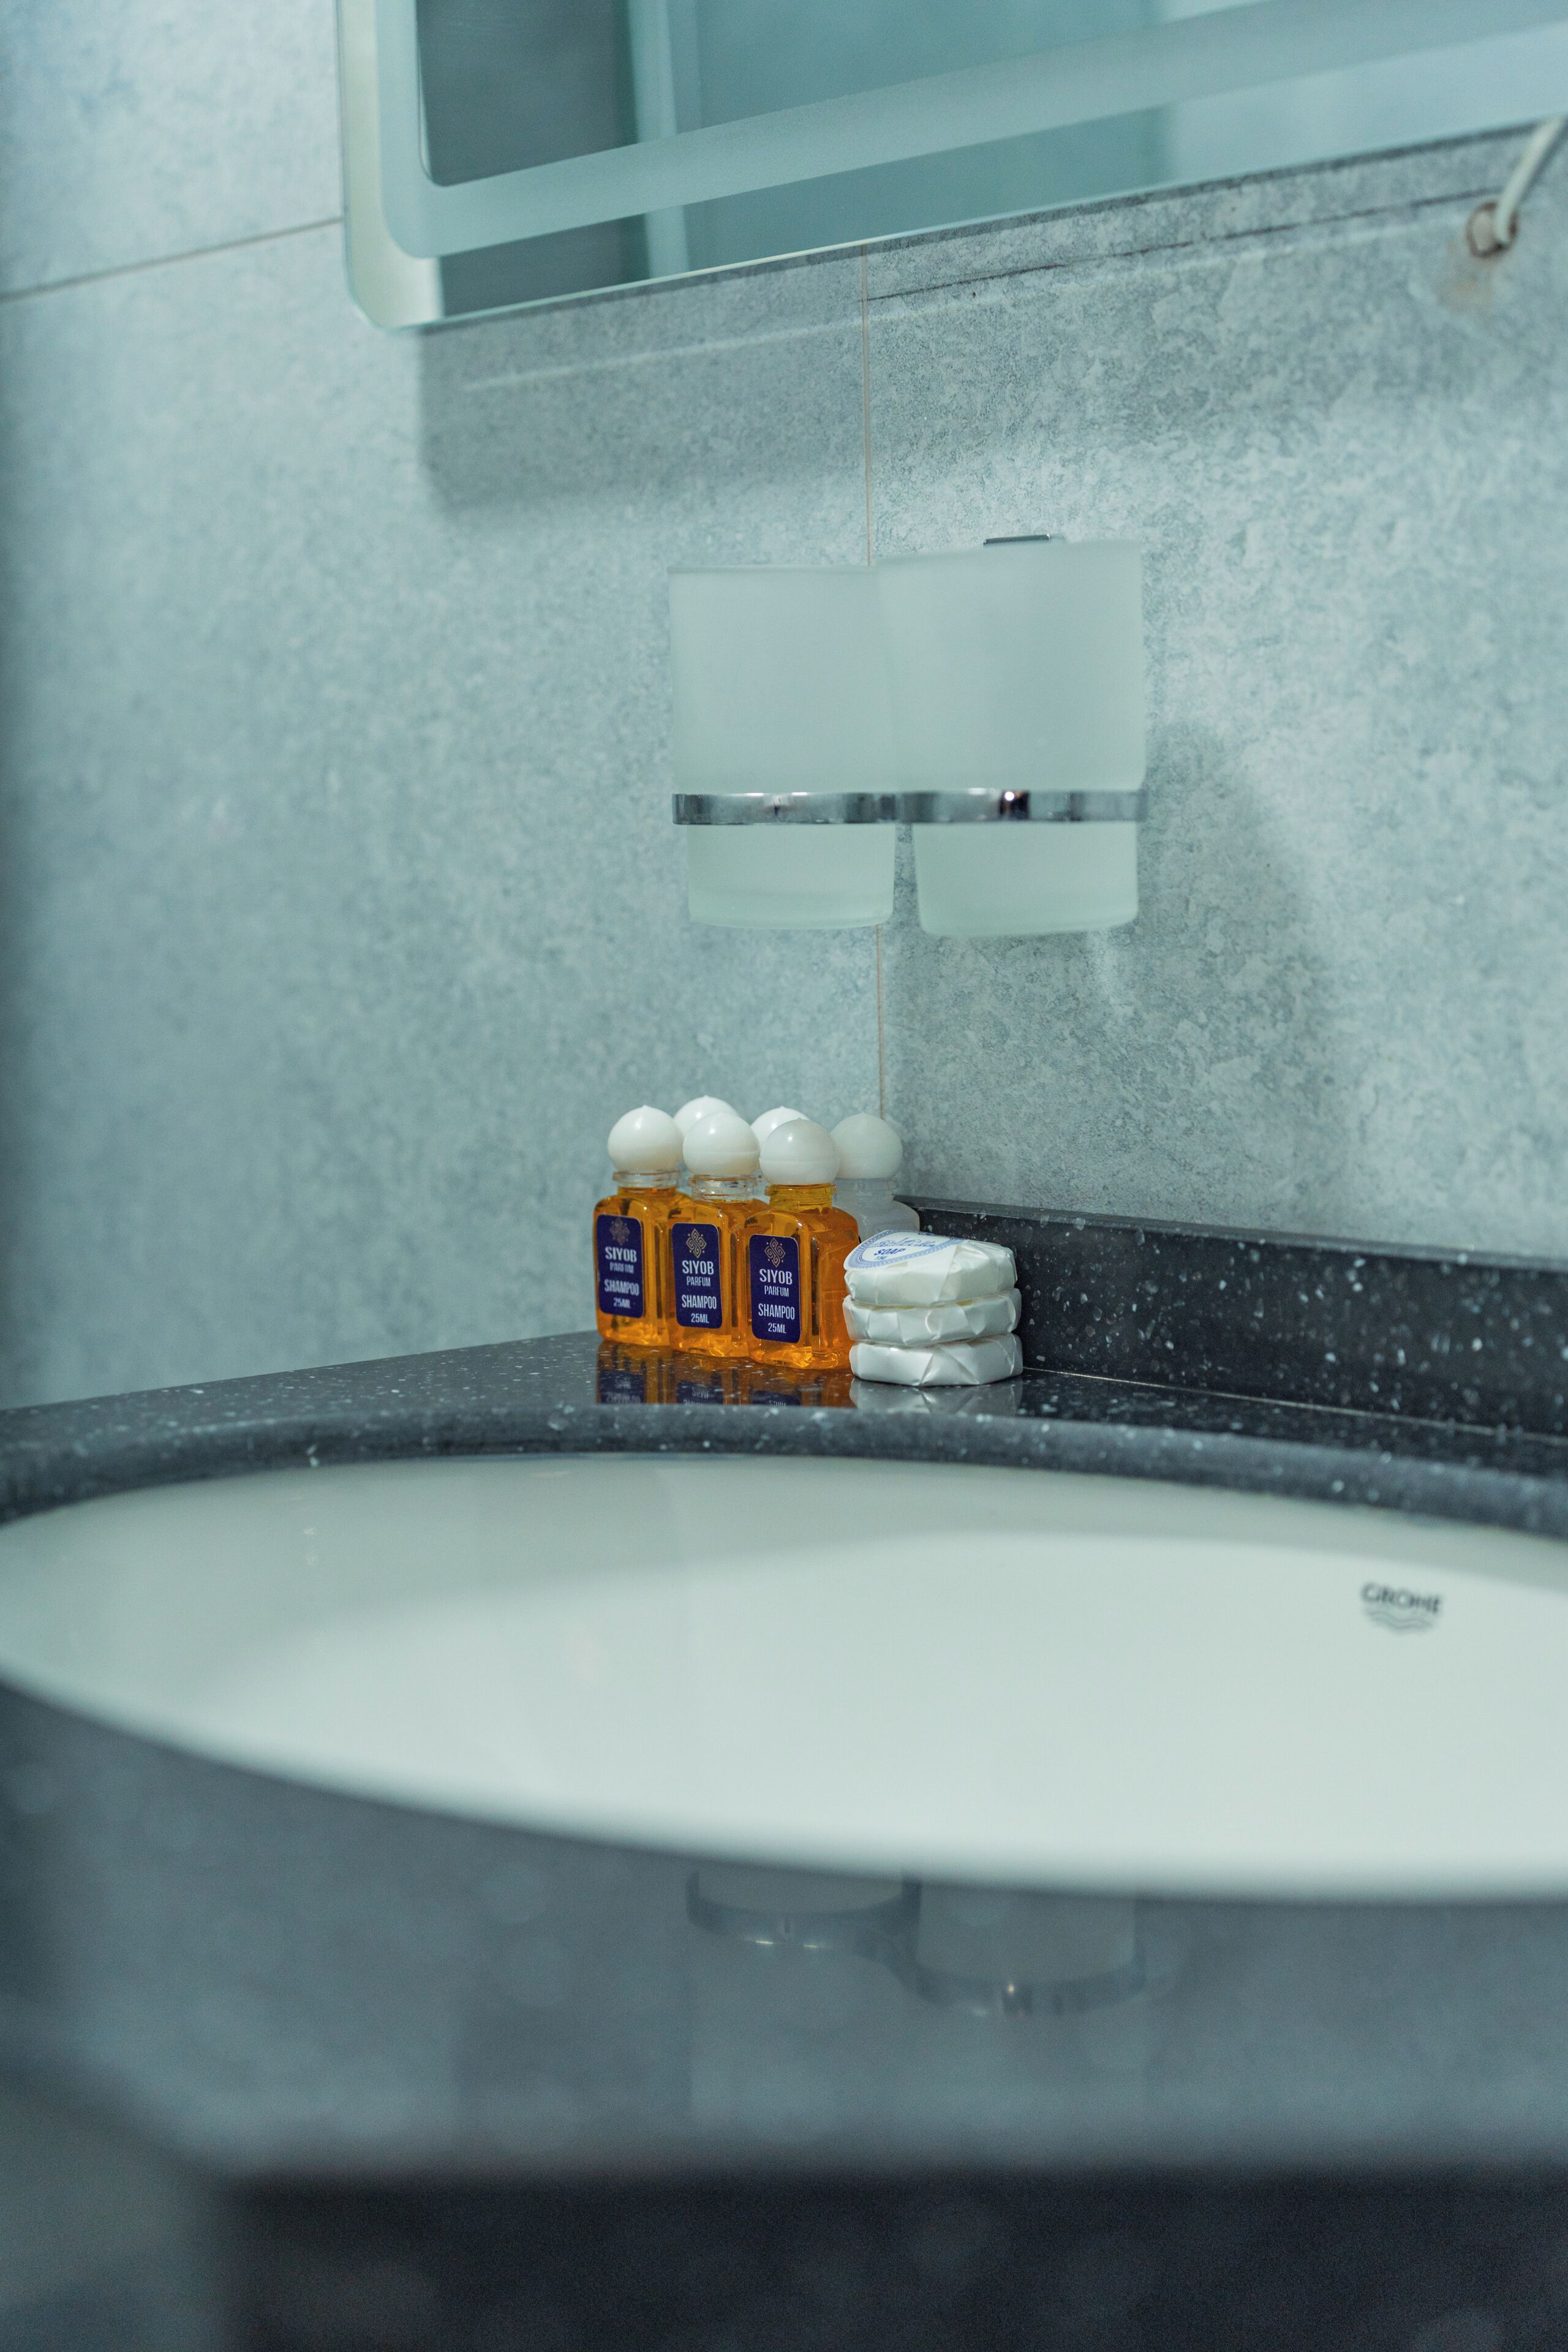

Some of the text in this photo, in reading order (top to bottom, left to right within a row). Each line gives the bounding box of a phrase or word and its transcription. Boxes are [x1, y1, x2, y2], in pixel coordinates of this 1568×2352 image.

[605, 1246, 638, 1262] SIYOB
[682, 1260, 714, 1275] SIYOB
[687, 1276, 711, 1287] PARFUM
[759, 1268, 793, 1285] SIYOB
[604, 1278, 639, 1296] SHAMPOO
[764, 1285, 789, 1297] PARFUM
[613, 1297, 631, 1309] 25ML
[681, 1294, 717, 1310] SHAMPOO
[691, 1313, 710, 1324] 25ML
[758, 1303, 795, 1320] SHAMPOO
[767, 1322, 786, 1334] 25ML
[1361, 1582, 1441, 1613] GROHE
